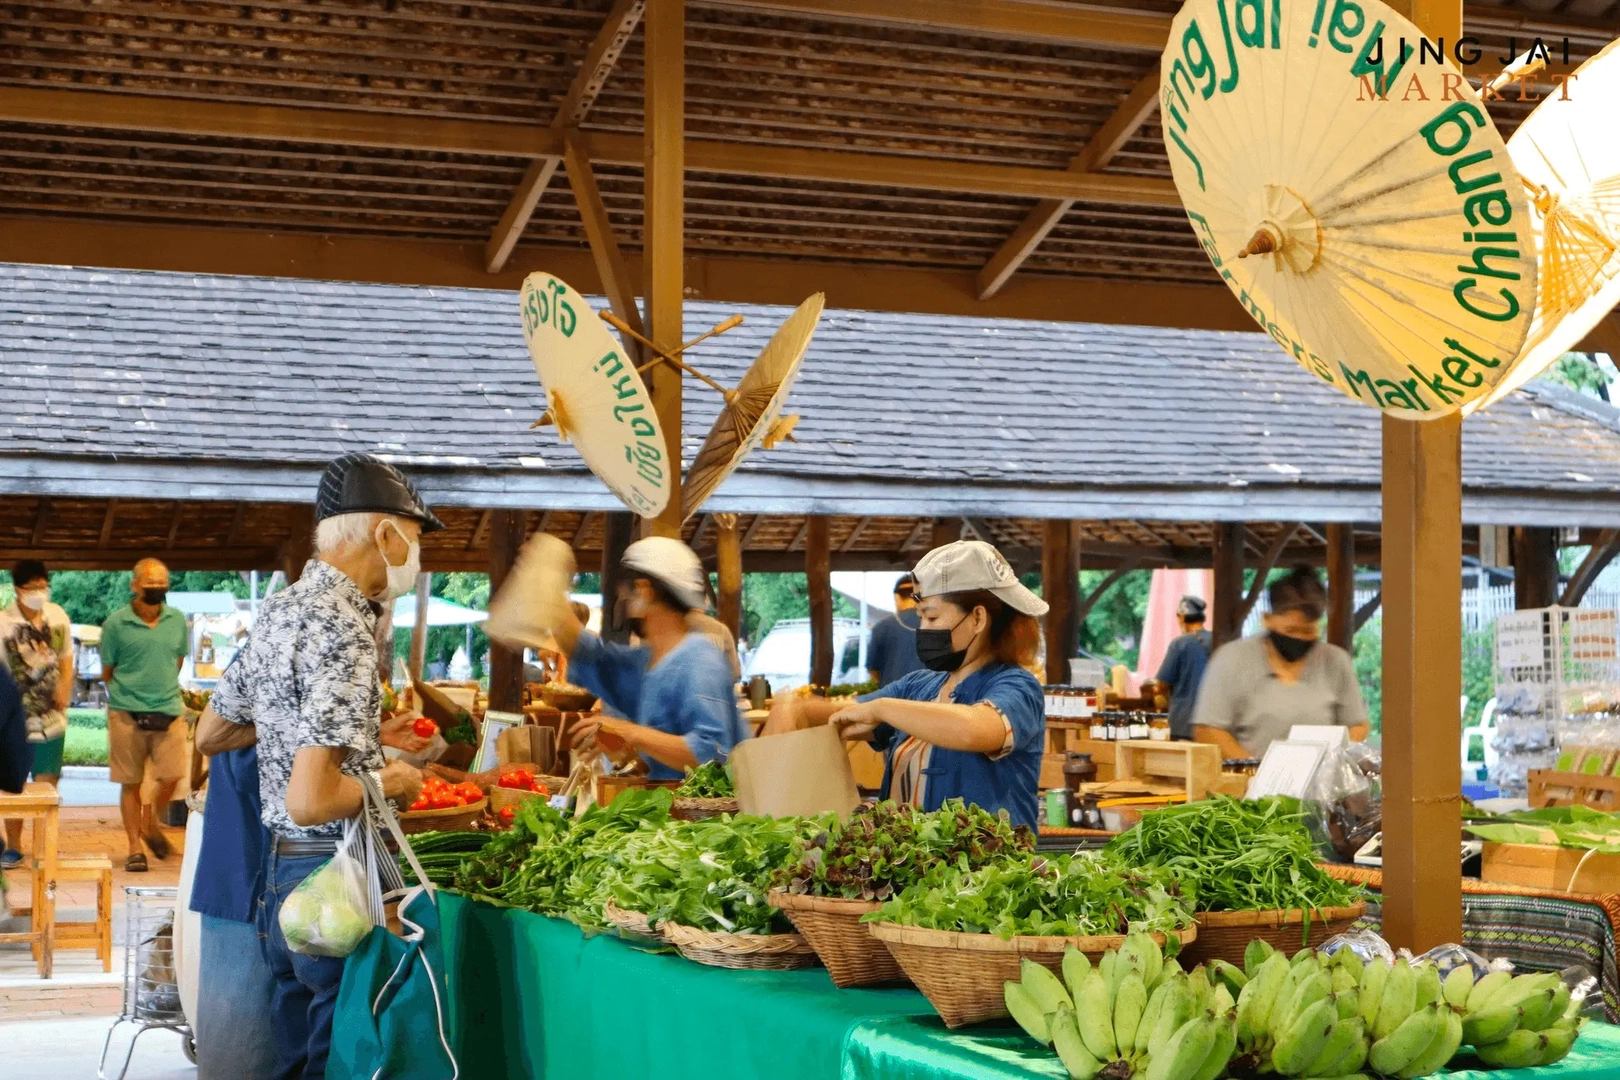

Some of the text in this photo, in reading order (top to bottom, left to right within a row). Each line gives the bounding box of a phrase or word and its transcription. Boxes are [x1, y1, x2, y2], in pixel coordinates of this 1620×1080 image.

[1168, 18, 1217, 193] Jing
[1186, 0, 1521, 412] Farmers Market Chiang Mai
[592, 350, 664, 488] เชียงใหม่
